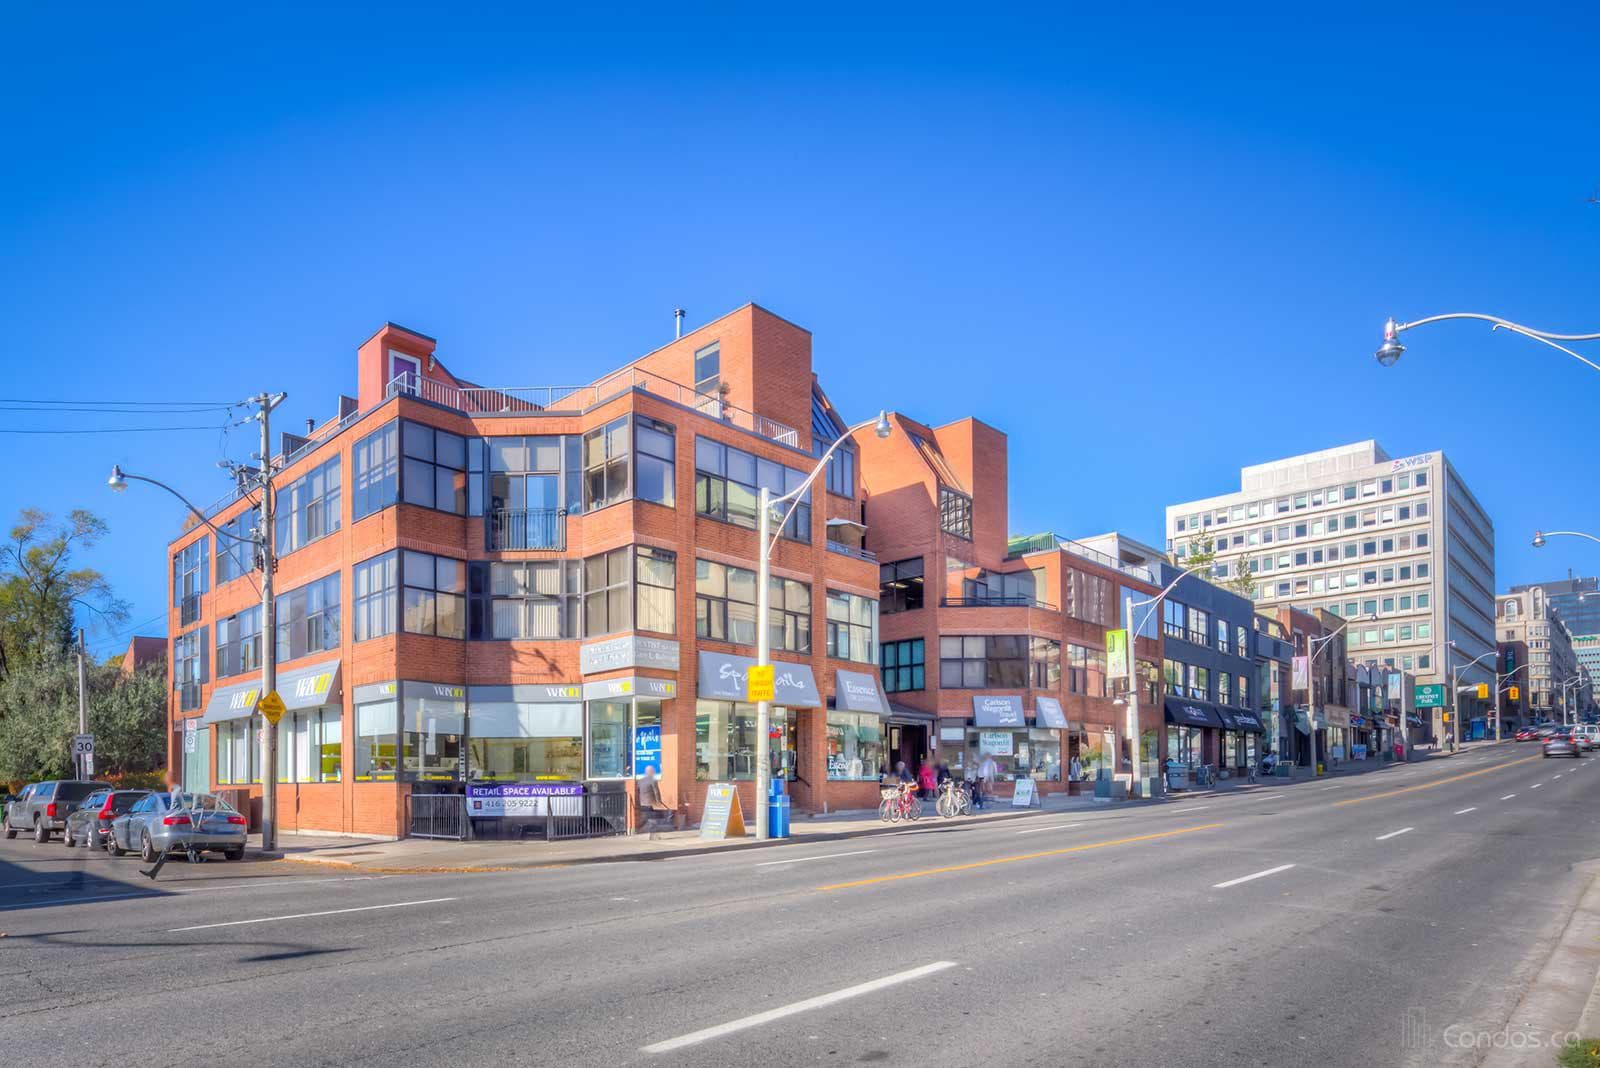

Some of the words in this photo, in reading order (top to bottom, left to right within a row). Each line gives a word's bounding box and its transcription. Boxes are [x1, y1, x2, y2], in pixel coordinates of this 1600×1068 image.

[982, 705, 1012, 713] Wagonlit
[77, 742, 92, 752] 30
[472, 788, 500, 796] RETAIL
[503, 787, 528, 796] SPACE
[531, 787, 576, 796] AVAILABLE
[485, 799, 501, 808] 416
[519, 799, 538, 808] 9222
